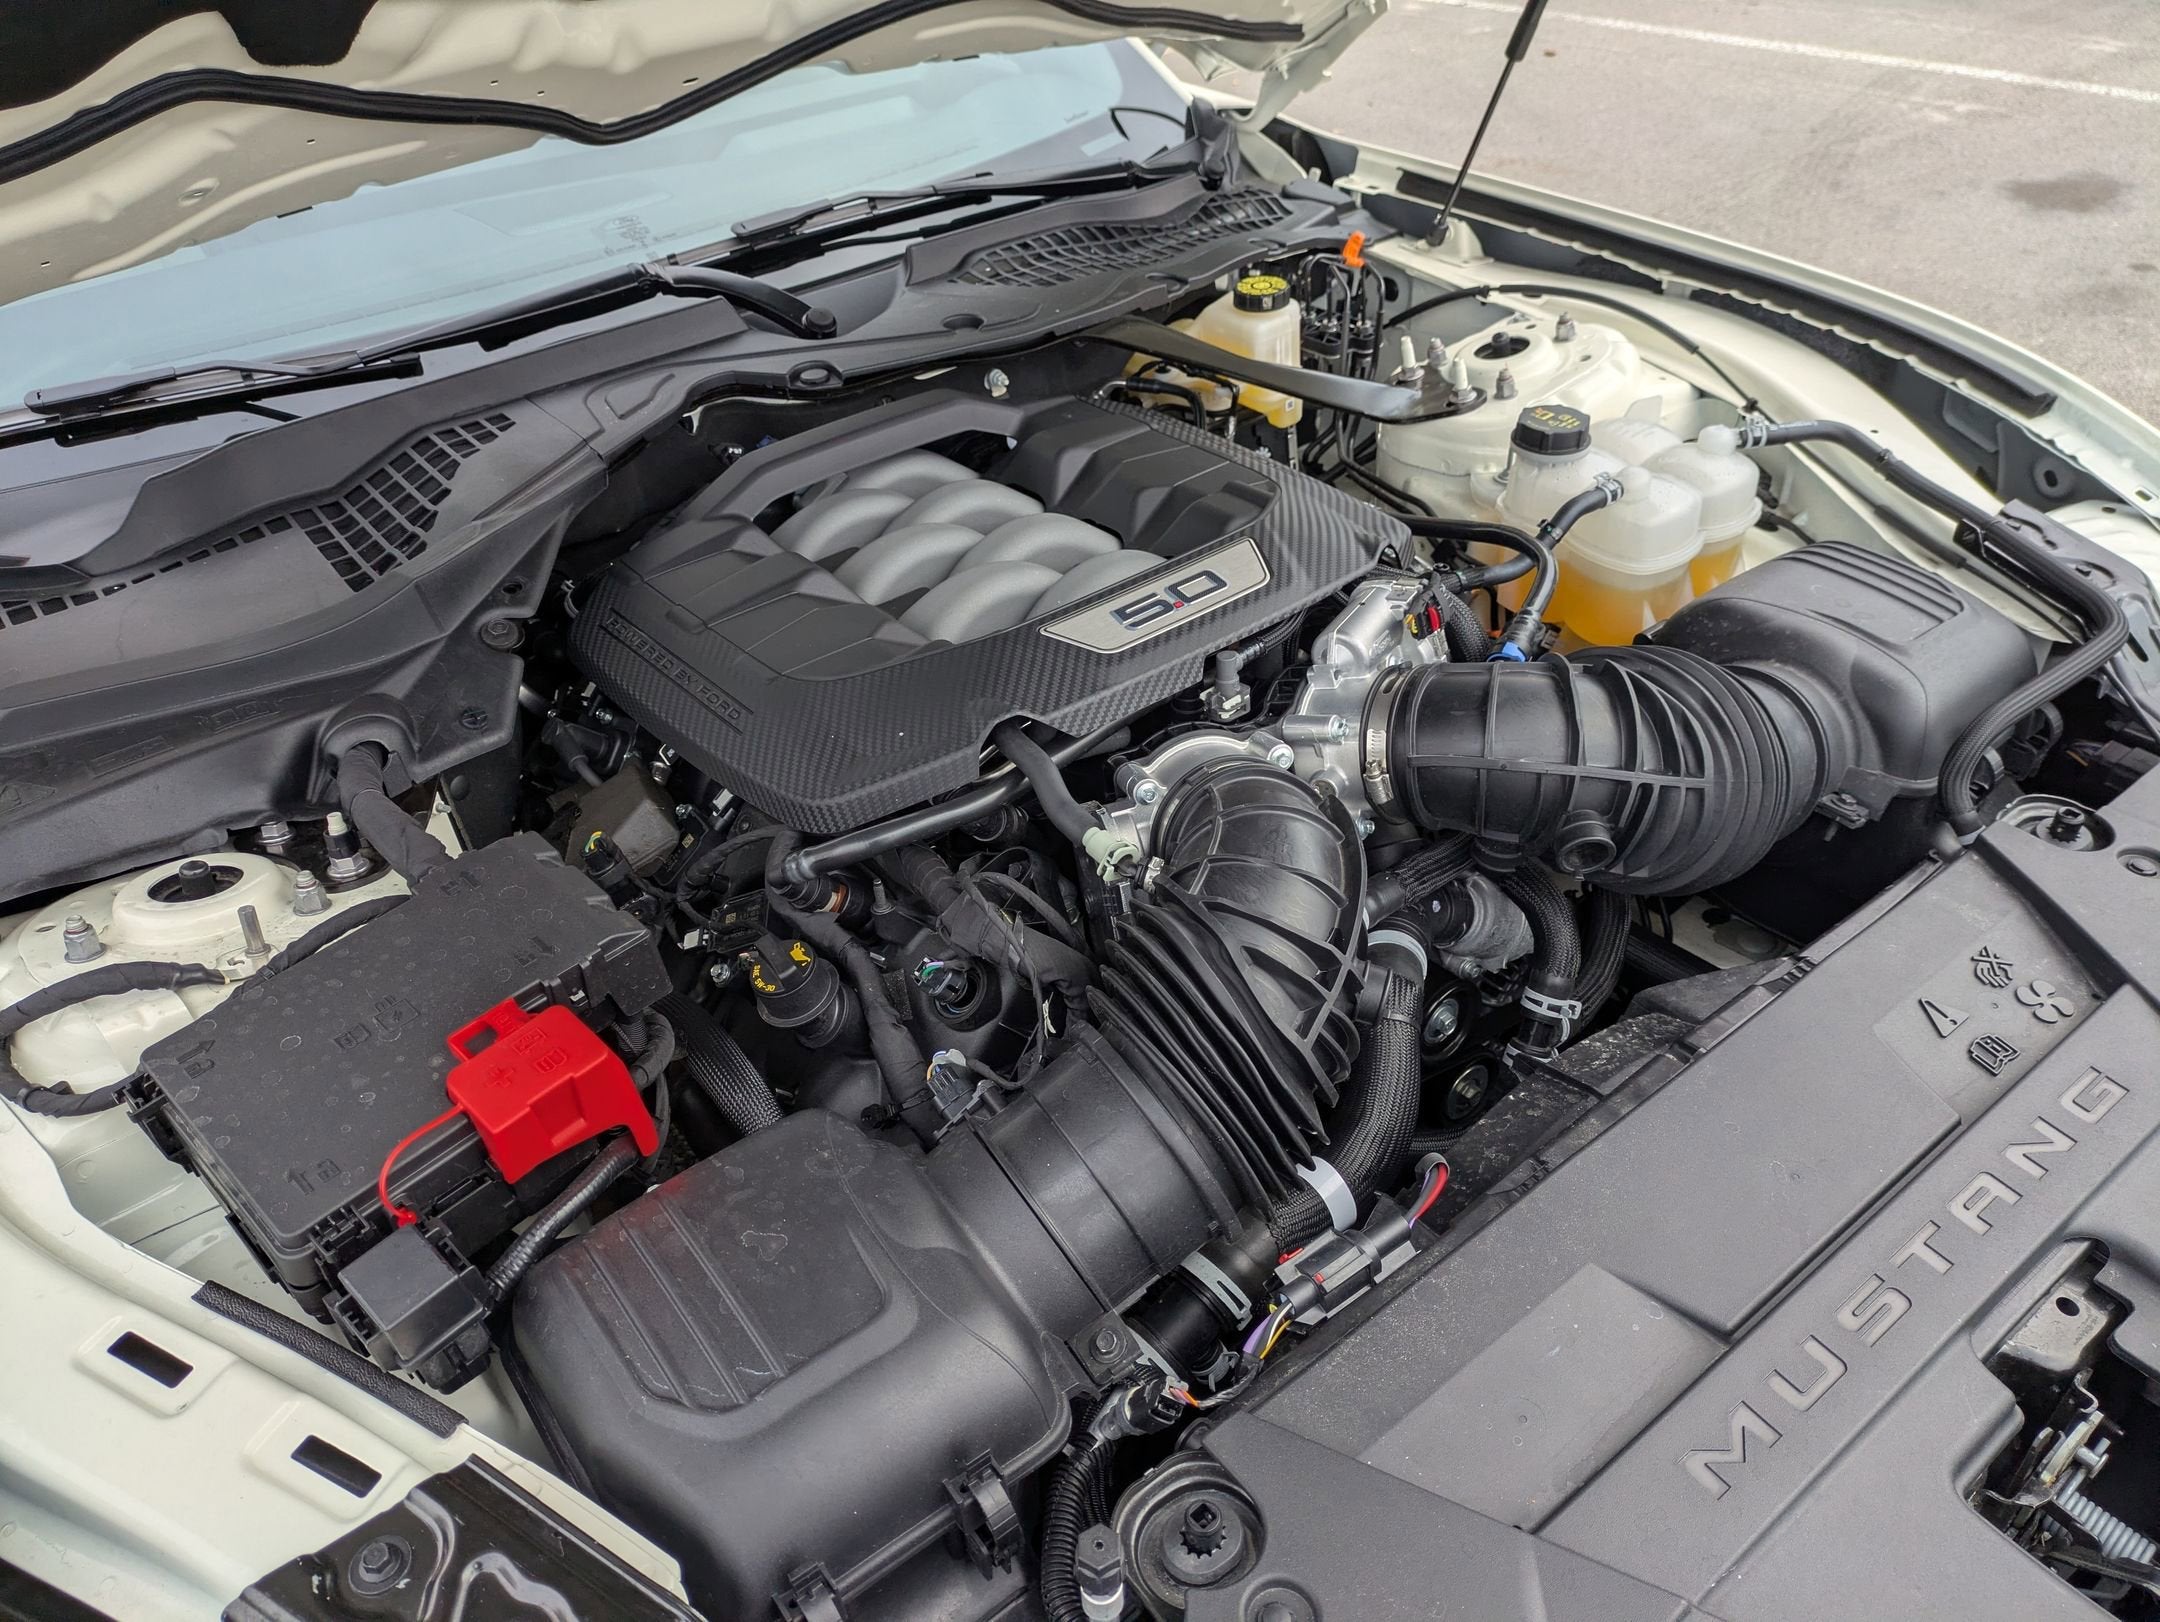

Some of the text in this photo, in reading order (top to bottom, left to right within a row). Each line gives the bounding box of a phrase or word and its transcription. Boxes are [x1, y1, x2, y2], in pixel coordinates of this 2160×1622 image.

[1109, 568, 1231, 631] 5.0
[606, 617, 742, 721] POWERED BY FORD
[1674, 1065, 2130, 1501] MUSTANG
